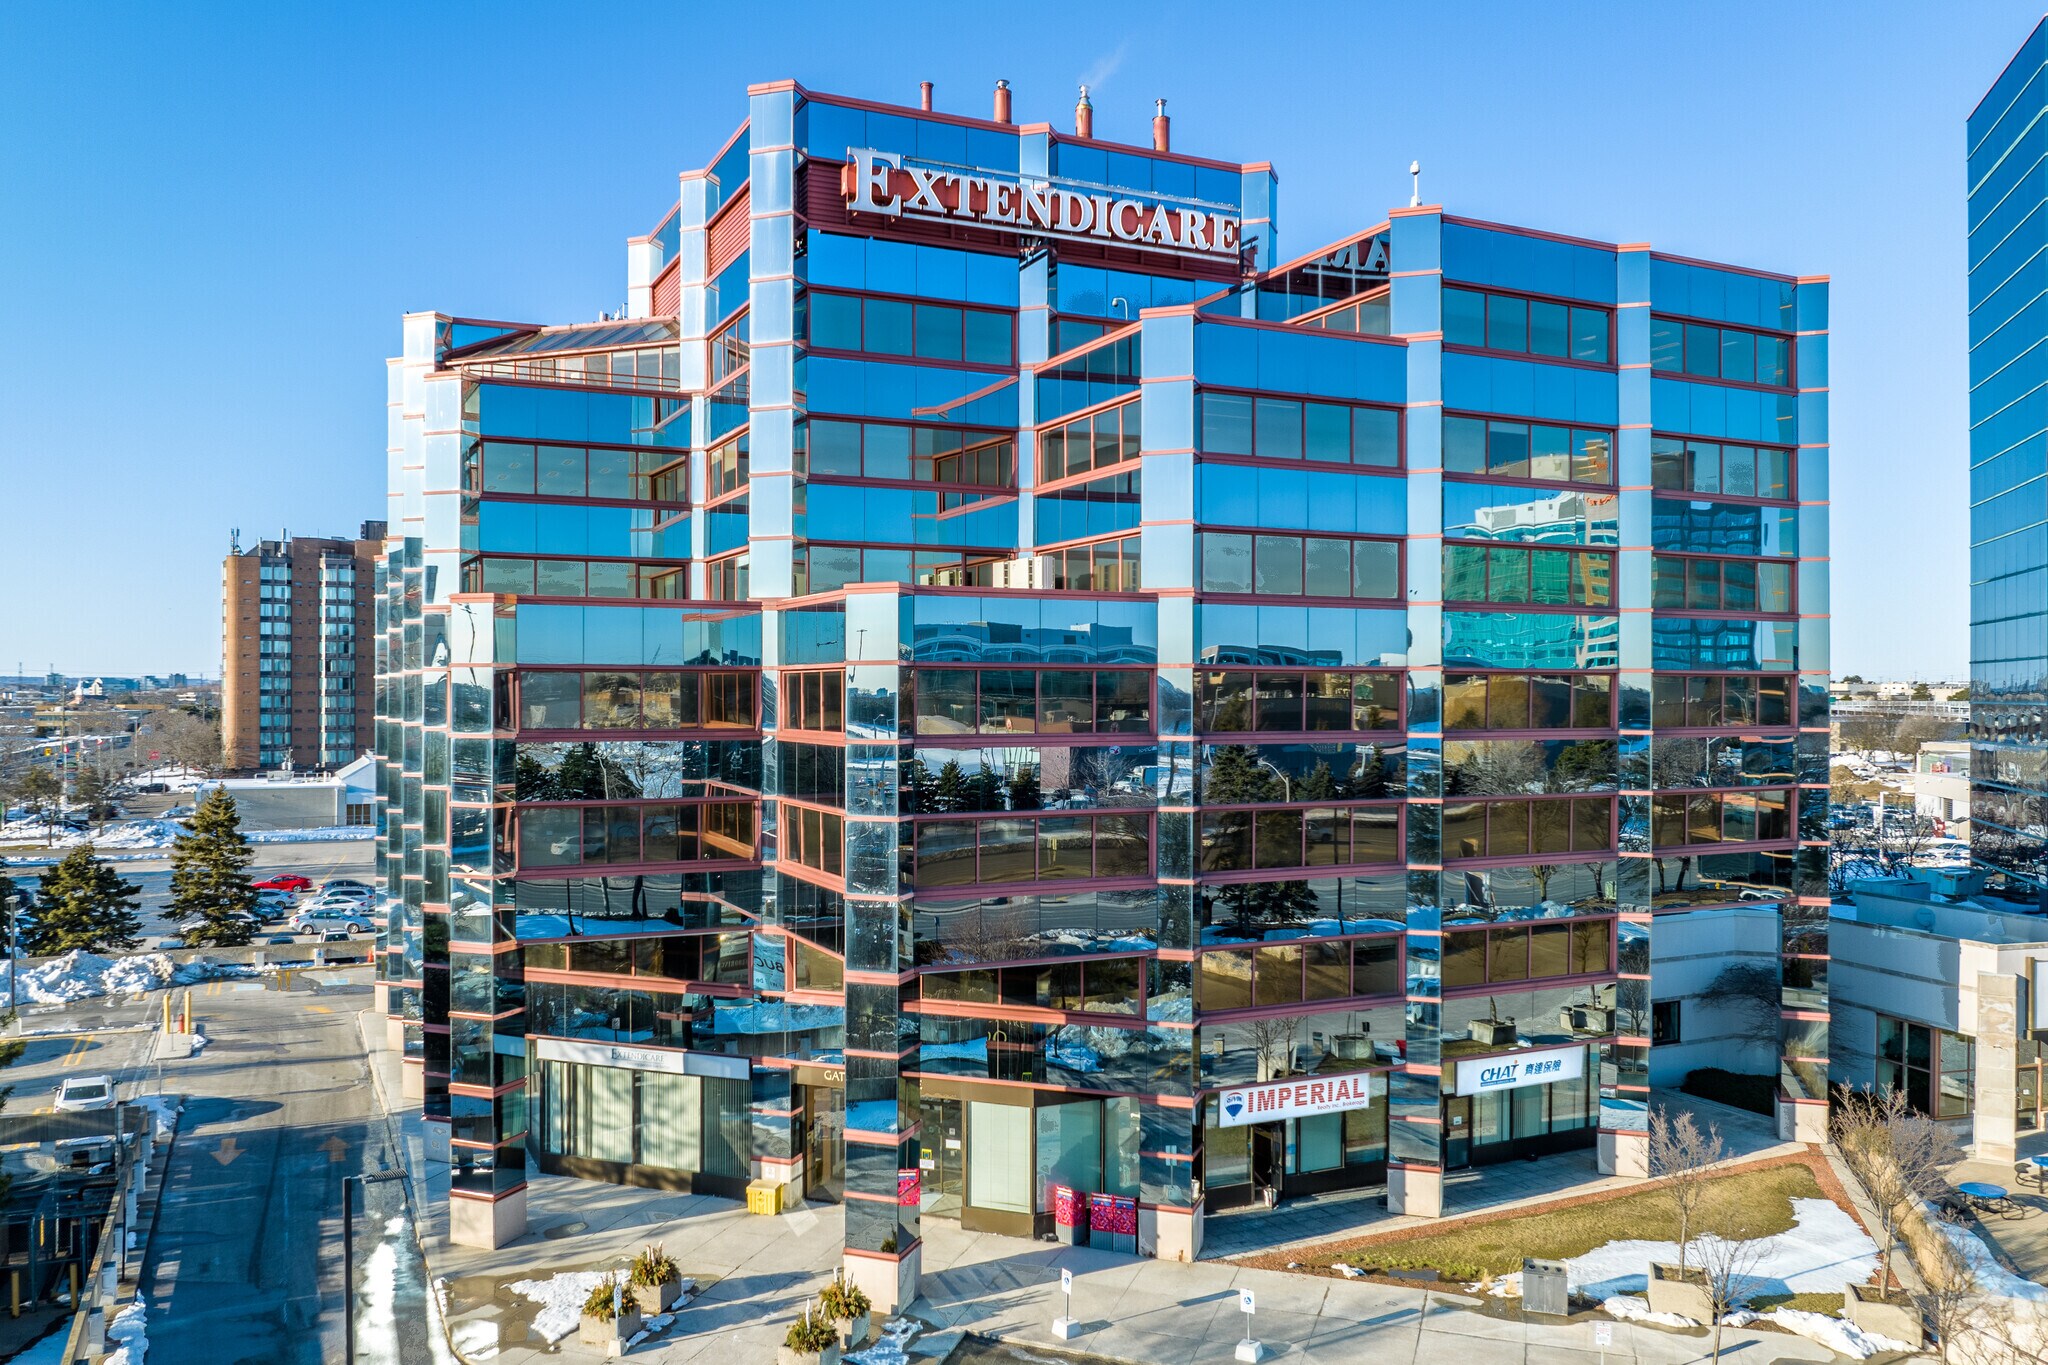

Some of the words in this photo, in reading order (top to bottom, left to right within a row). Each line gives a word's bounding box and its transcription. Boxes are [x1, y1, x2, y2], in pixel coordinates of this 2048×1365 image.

[846, 146, 1240, 254] EXTENDICARE
[611, 1048, 665, 1062] EXTENDICARE
[1481, 1061, 1520, 1082] CHAT
[1248, 1078, 1365, 1113] IMPERIAL
